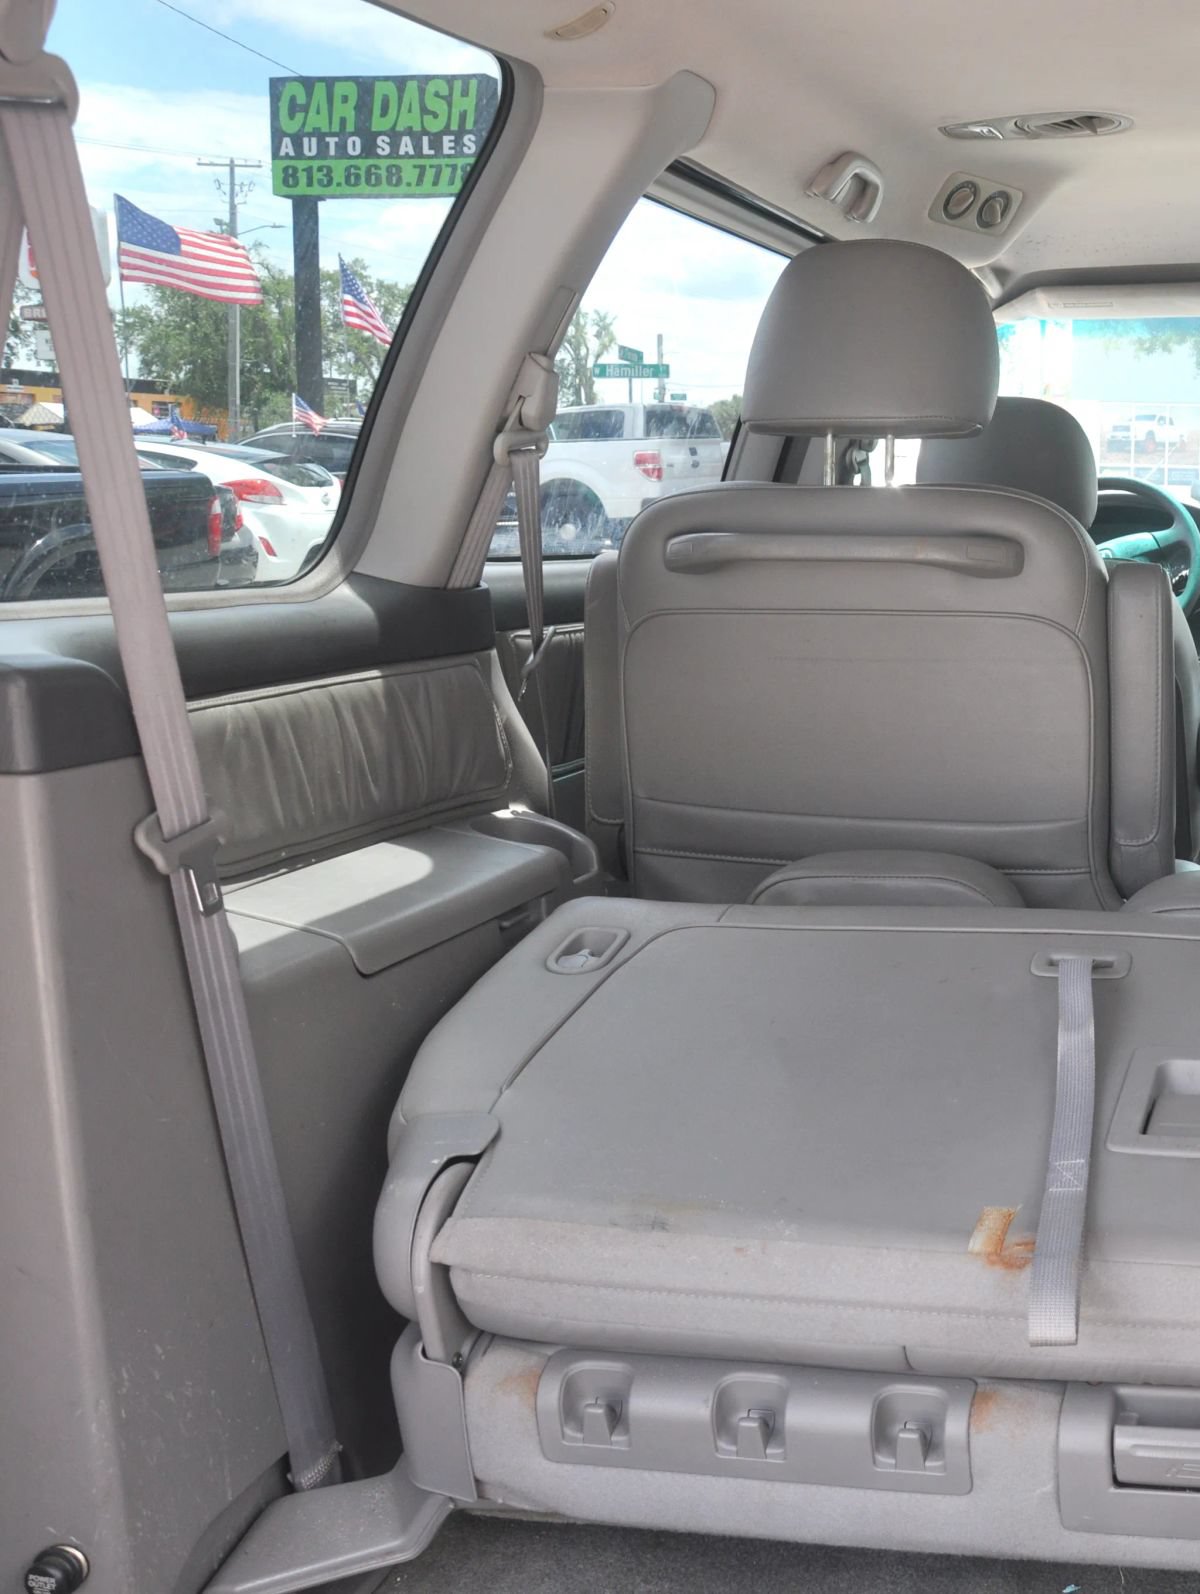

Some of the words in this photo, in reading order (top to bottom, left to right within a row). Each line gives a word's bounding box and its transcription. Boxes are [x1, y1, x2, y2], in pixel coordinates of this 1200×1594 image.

[279, 81, 358, 134] CAR
[371, 79, 478, 133] DASH
[280, 137, 362, 156] AUTO
[376, 134, 477, 155] SALES
[606, 365, 654, 377] Hamiller
